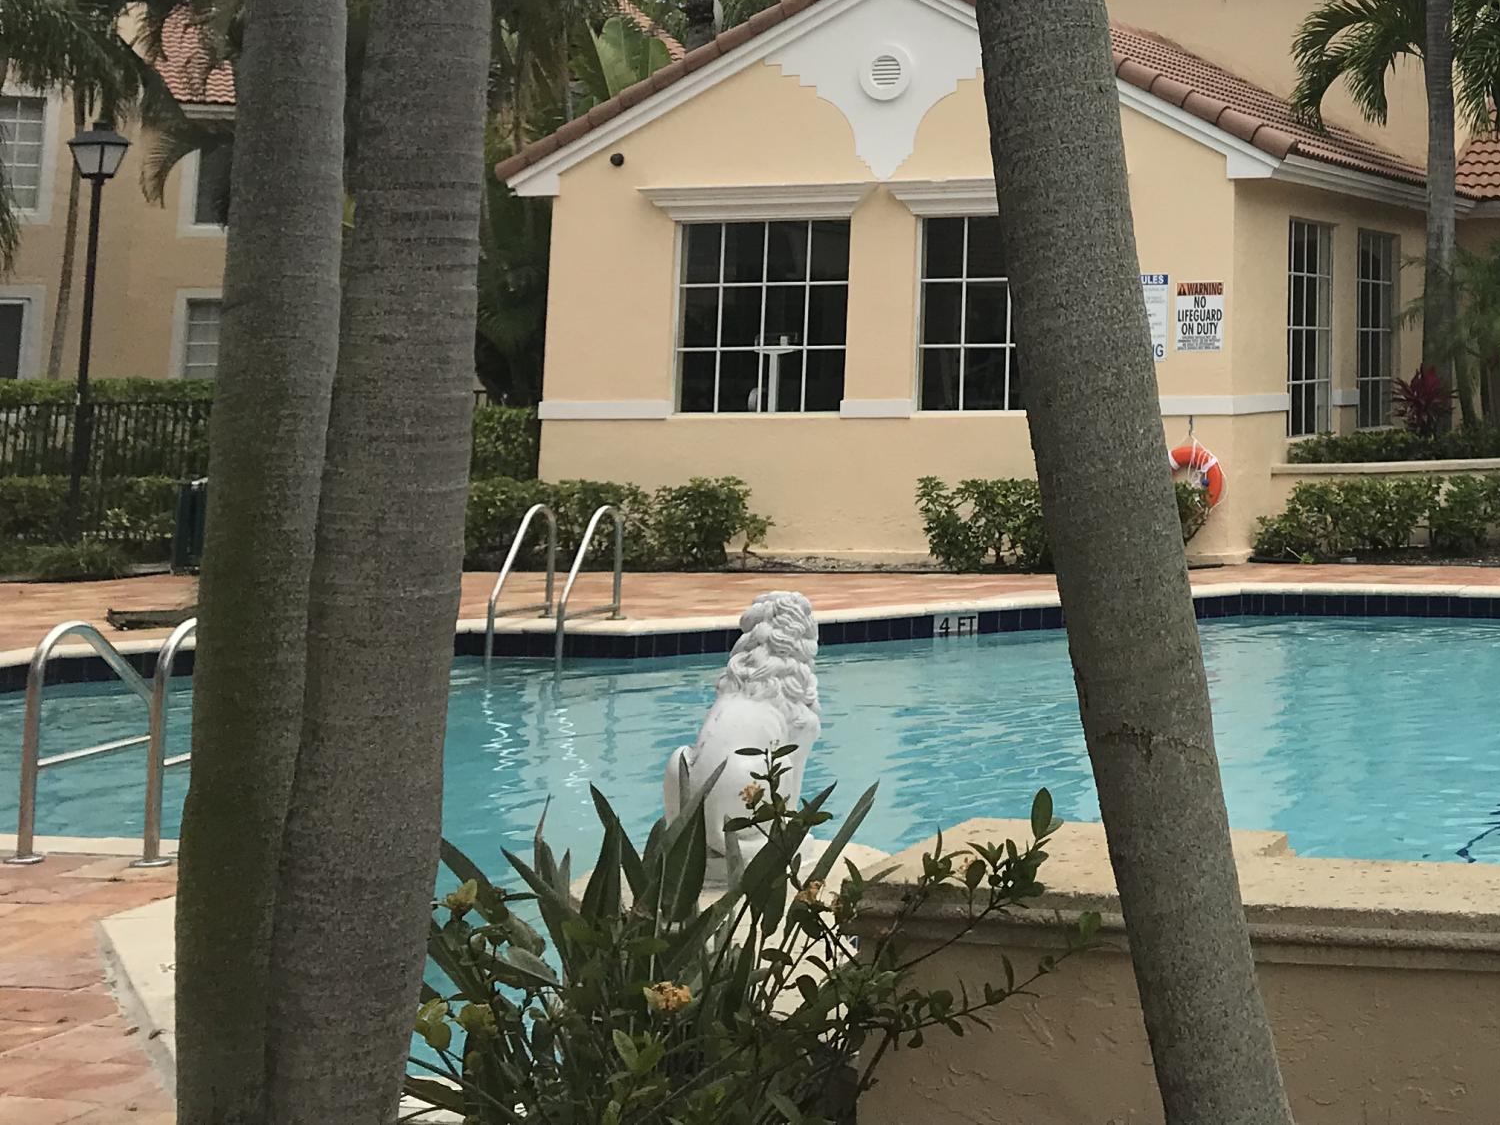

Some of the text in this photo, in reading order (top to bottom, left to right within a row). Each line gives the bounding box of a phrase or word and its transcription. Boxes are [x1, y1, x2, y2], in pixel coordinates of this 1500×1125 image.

[1141, 275, 1164, 284] ULES
[1187, 283, 1223, 295] WARNING
[1194, 296, 1206, 308] NO
[1178, 309, 1222, 322] LIFEGUARD
[1181, 322, 1219, 335] ON DUTY
[939, 616, 976, 635] 4 FT
